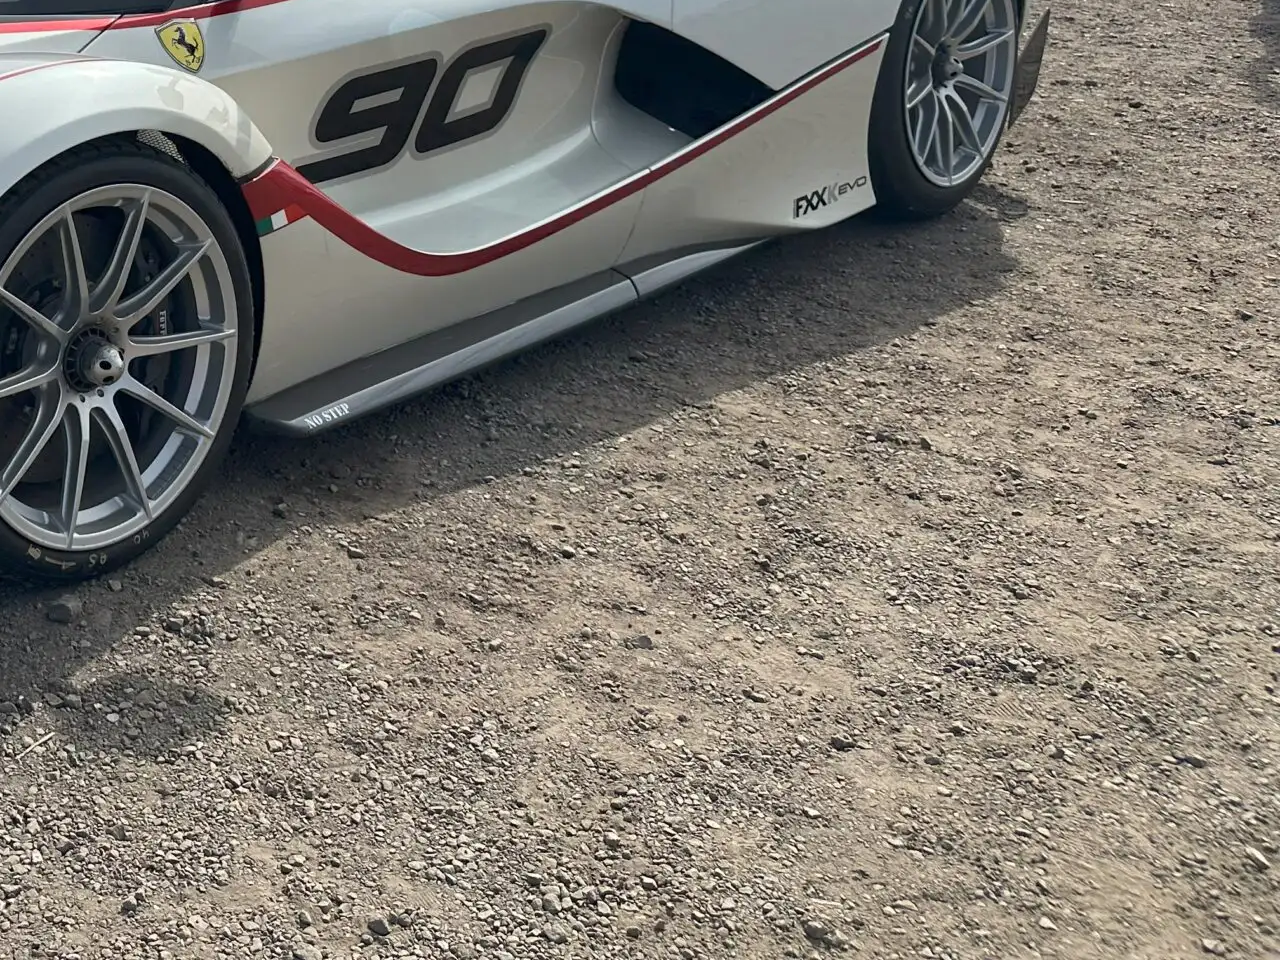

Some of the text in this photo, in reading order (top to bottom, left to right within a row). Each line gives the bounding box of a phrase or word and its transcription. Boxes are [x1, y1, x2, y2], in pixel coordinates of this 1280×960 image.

[292, 25, 551, 186] 90
[838, 176, 867, 196] EVO
[304, 403, 350, 429] NO STEP
